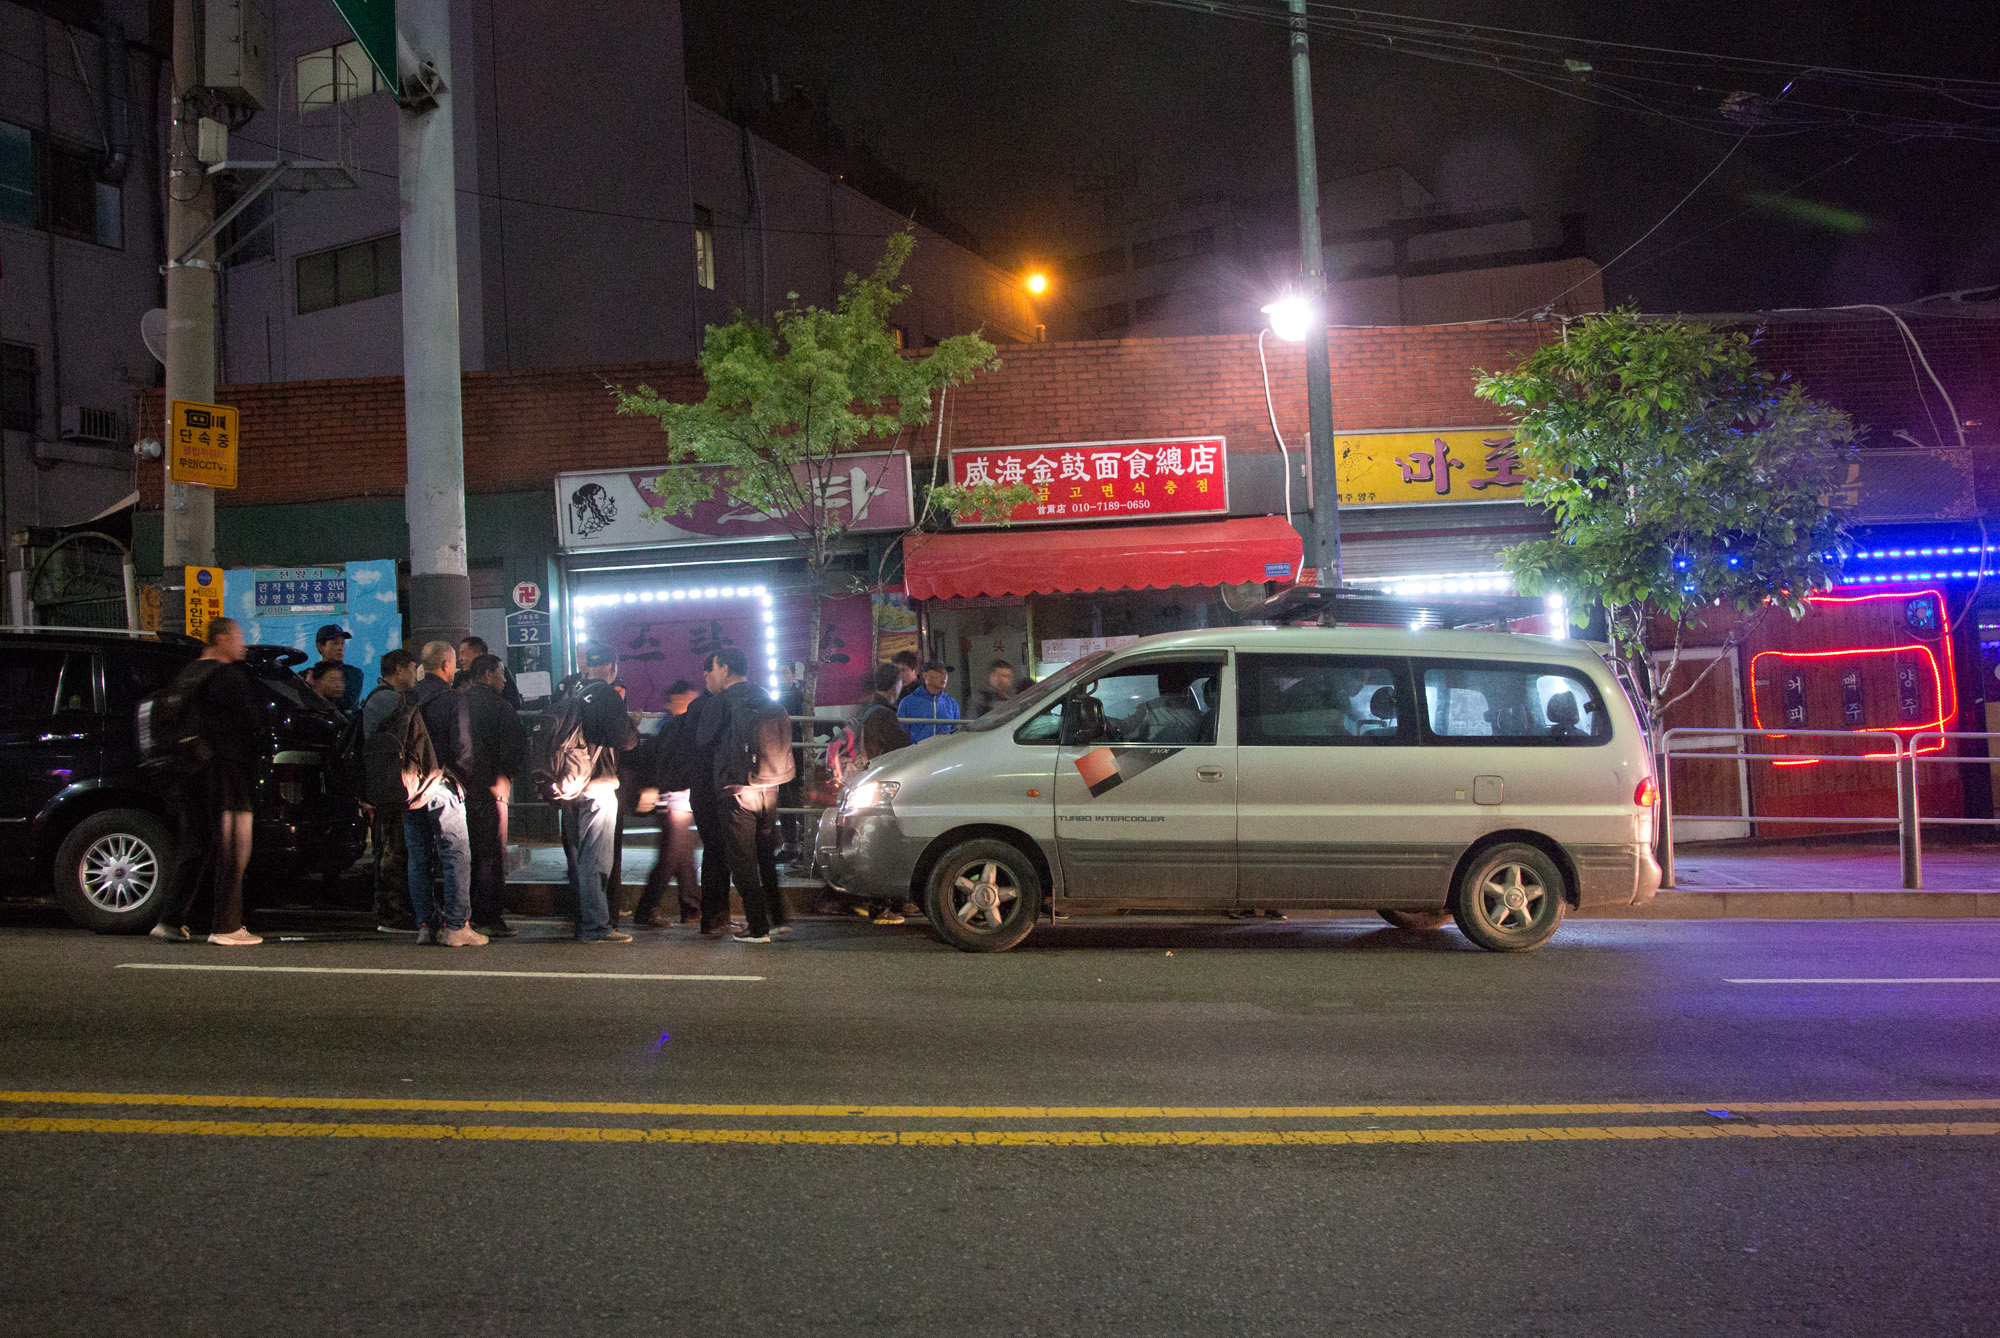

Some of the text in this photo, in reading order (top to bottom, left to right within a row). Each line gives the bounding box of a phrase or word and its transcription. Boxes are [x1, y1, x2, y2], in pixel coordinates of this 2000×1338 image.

[179, 429, 230, 448] 단속중
[963, 444, 1217, 487] 威海金鼓面食總店
[1071, 500, 1151, 514] 010-7189-0650
[189, 598, 204, 638] 무인단속
[520, 628, 539, 642] 32
[1787, 676, 1803, 723] 커피
[1844, 673, 1861, 721] 맥주
[1900, 669, 1916, 716] 양주
[1058, 815, 1165, 823] TURBO INTERCOOLER
